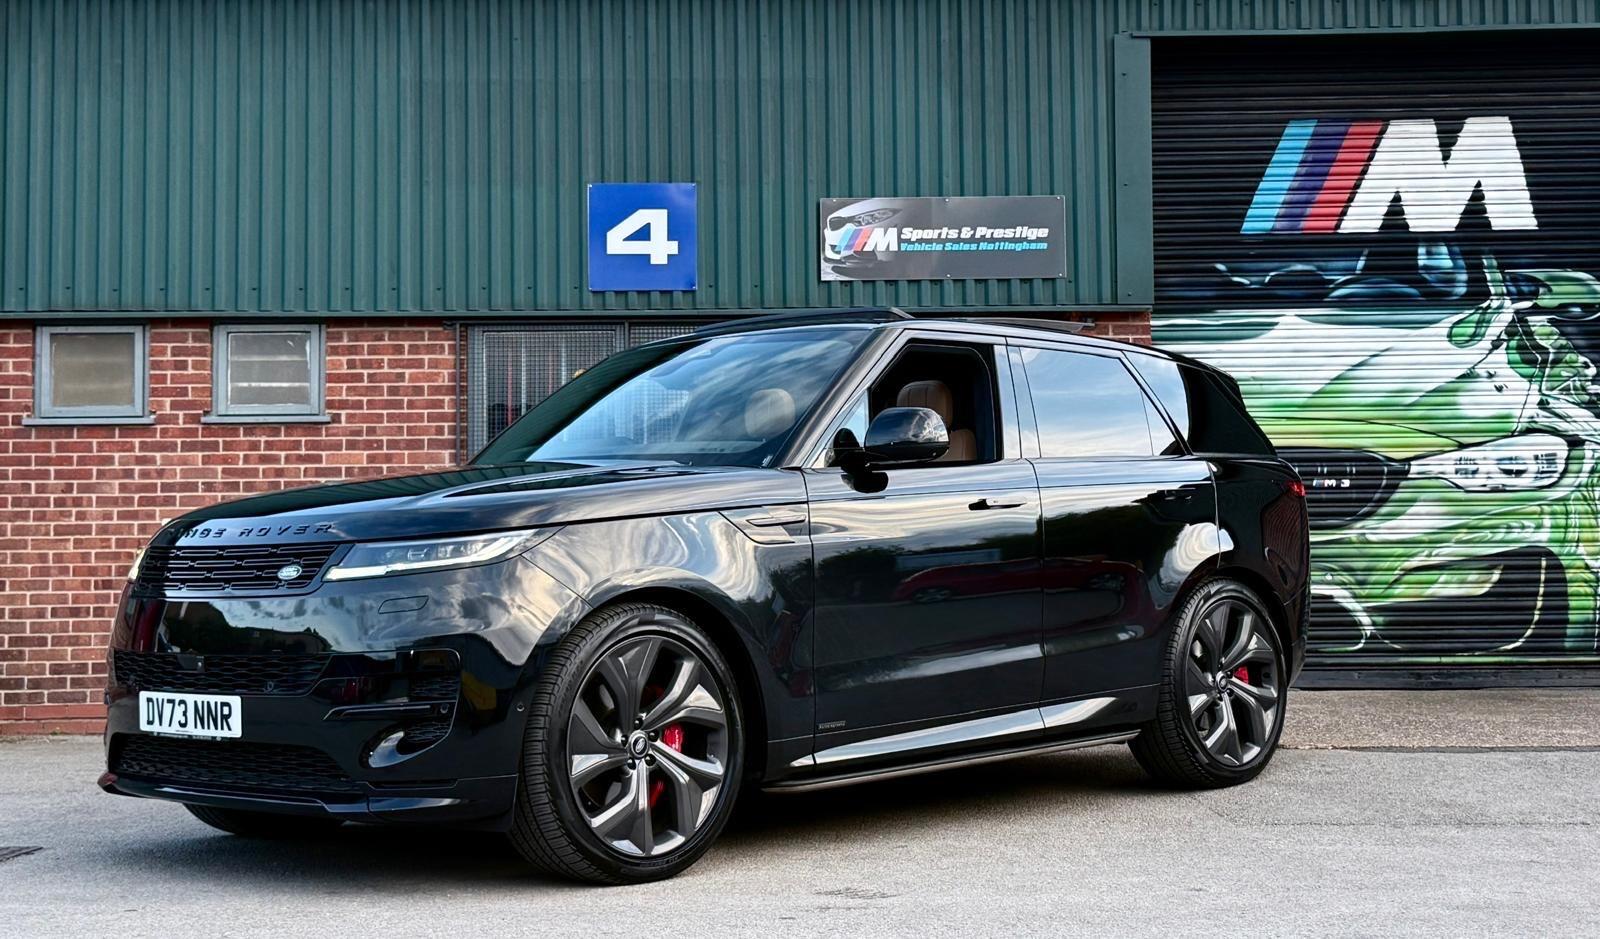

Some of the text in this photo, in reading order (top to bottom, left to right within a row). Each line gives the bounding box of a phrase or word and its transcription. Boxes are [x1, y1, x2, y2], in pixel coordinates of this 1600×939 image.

[606, 208, 678, 264] 4
[900, 226, 1049, 241] Sports & Prestige
[900, 242, 1048, 251] Vehicle Sales Nottingham
[238, 524, 333, 538] ROVER
[146, 697, 232, 731] DV73 NNR
